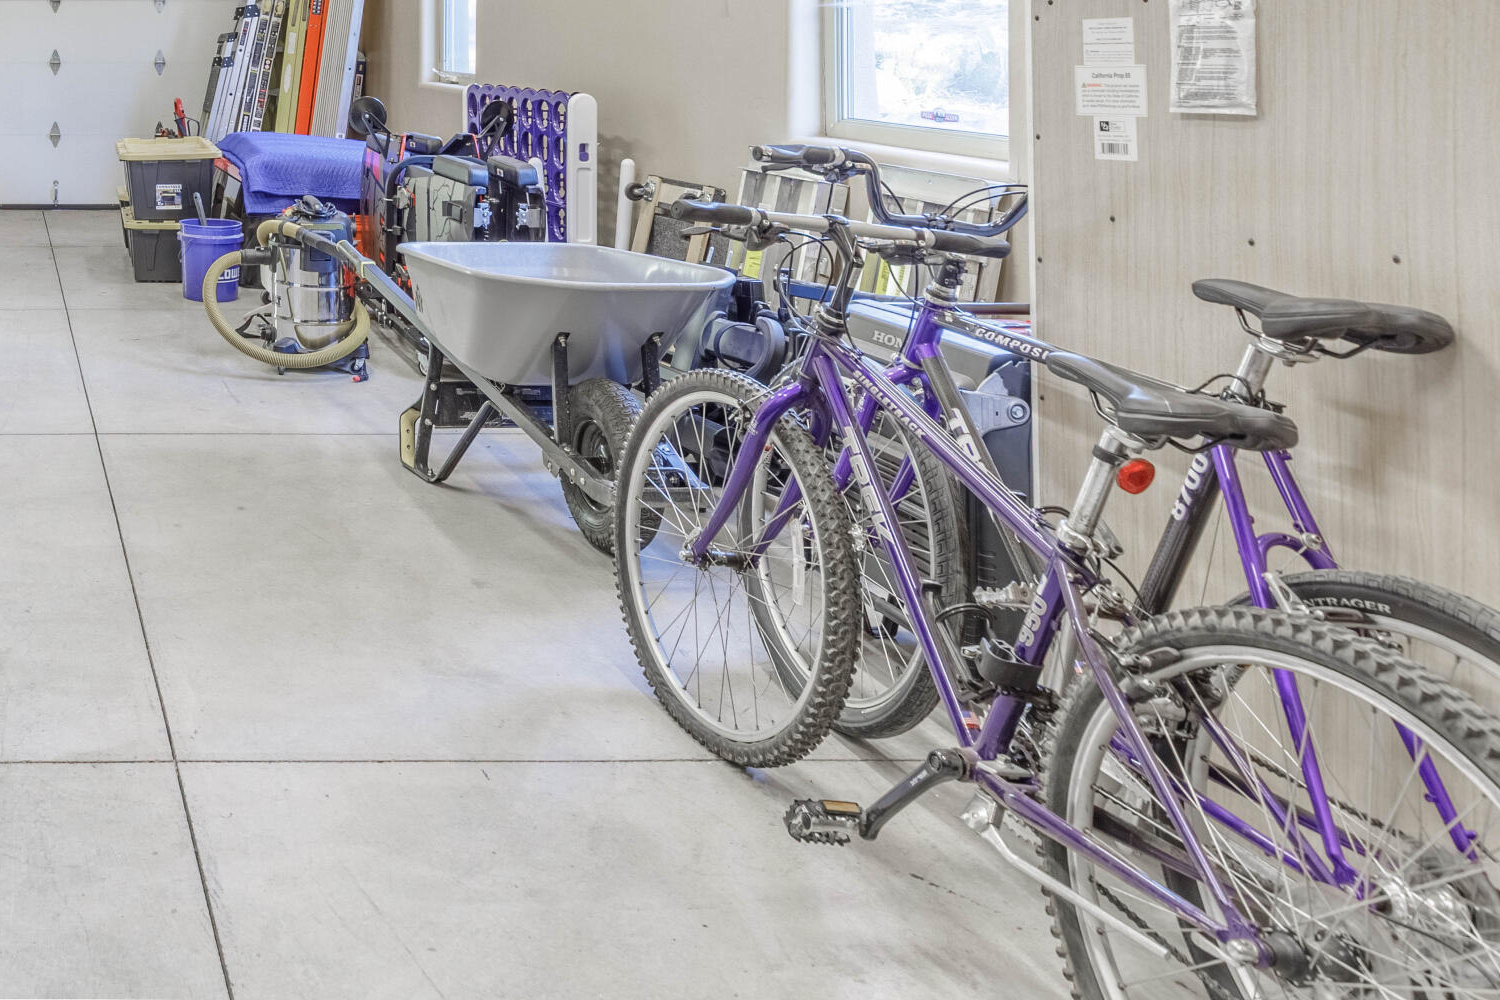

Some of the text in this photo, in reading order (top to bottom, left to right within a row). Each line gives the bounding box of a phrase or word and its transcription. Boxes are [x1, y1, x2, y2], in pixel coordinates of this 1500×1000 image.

[872, 330, 903, 349] HON
[975, 327, 1049, 360] COMPOSI
[853, 369, 927, 440] SINGLETRACK
[842, 425, 895, 545] TREK
[1171, 452, 1209, 521] 8700
[1018, 595, 1048, 648] 950
[1303, 596, 1392, 614] NTRAGER
